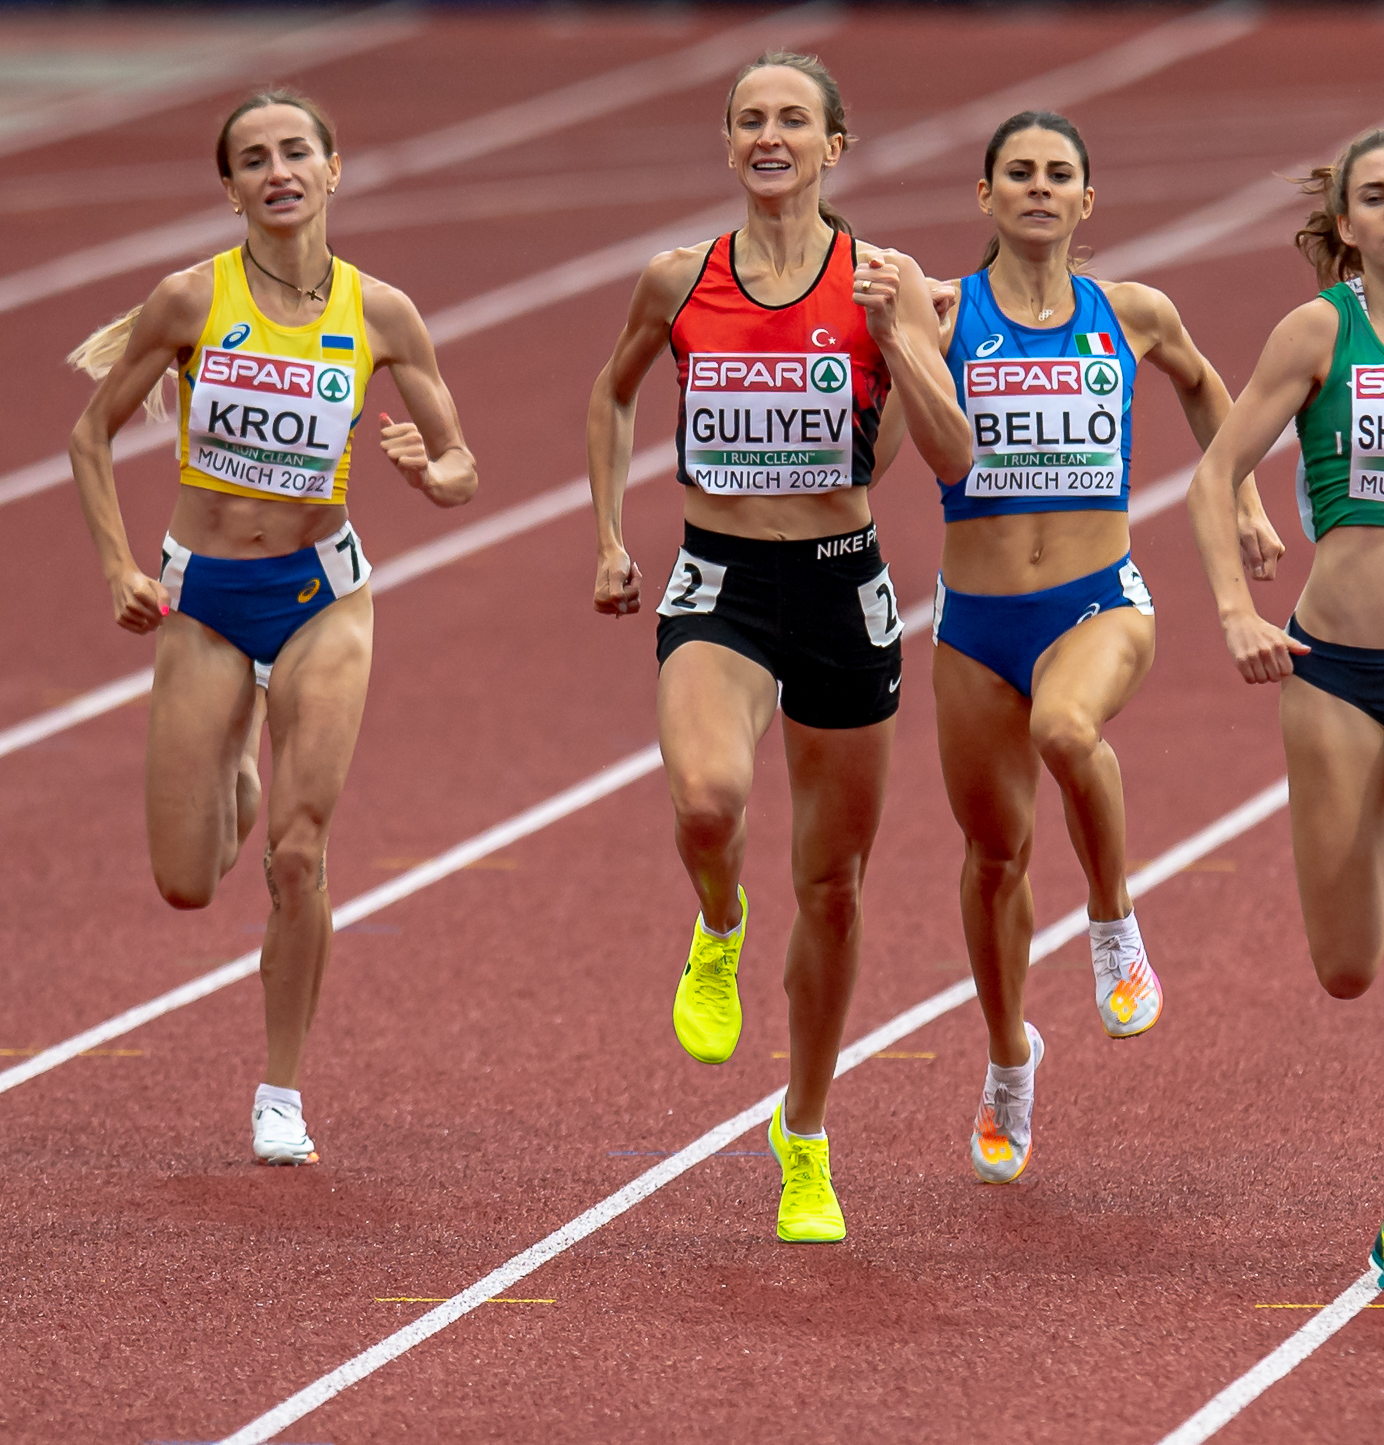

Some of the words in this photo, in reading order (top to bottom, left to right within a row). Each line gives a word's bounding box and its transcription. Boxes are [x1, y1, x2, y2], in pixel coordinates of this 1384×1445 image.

[204, 354, 312, 394] SPAR
[693, 360, 804, 388] SPAR
[970, 364, 1079, 393] SPAR
[207, 400, 330, 451] KROL
[692, 407, 848, 444] GULIYEV
[974, 403, 1117, 448] BELLÒ
[197, 446, 274, 486] MUNICH
[279, 470, 328, 493] 2022
[723, 452, 727, 464] I
[730, 452, 760, 465] RUN
[1011, 454, 1040, 466] RUN
[695, 469, 781, 490] MUNICH
[789, 468, 842, 489] 2022
[976, 471, 1060, 491] MUNICH
[1067, 471, 1115, 490] 2022
[334, 530, 362, 584] 7
[816, 534, 864, 560] NIKE
[670, 562, 703, 610] 2
[875, 582, 898, 635] 2
